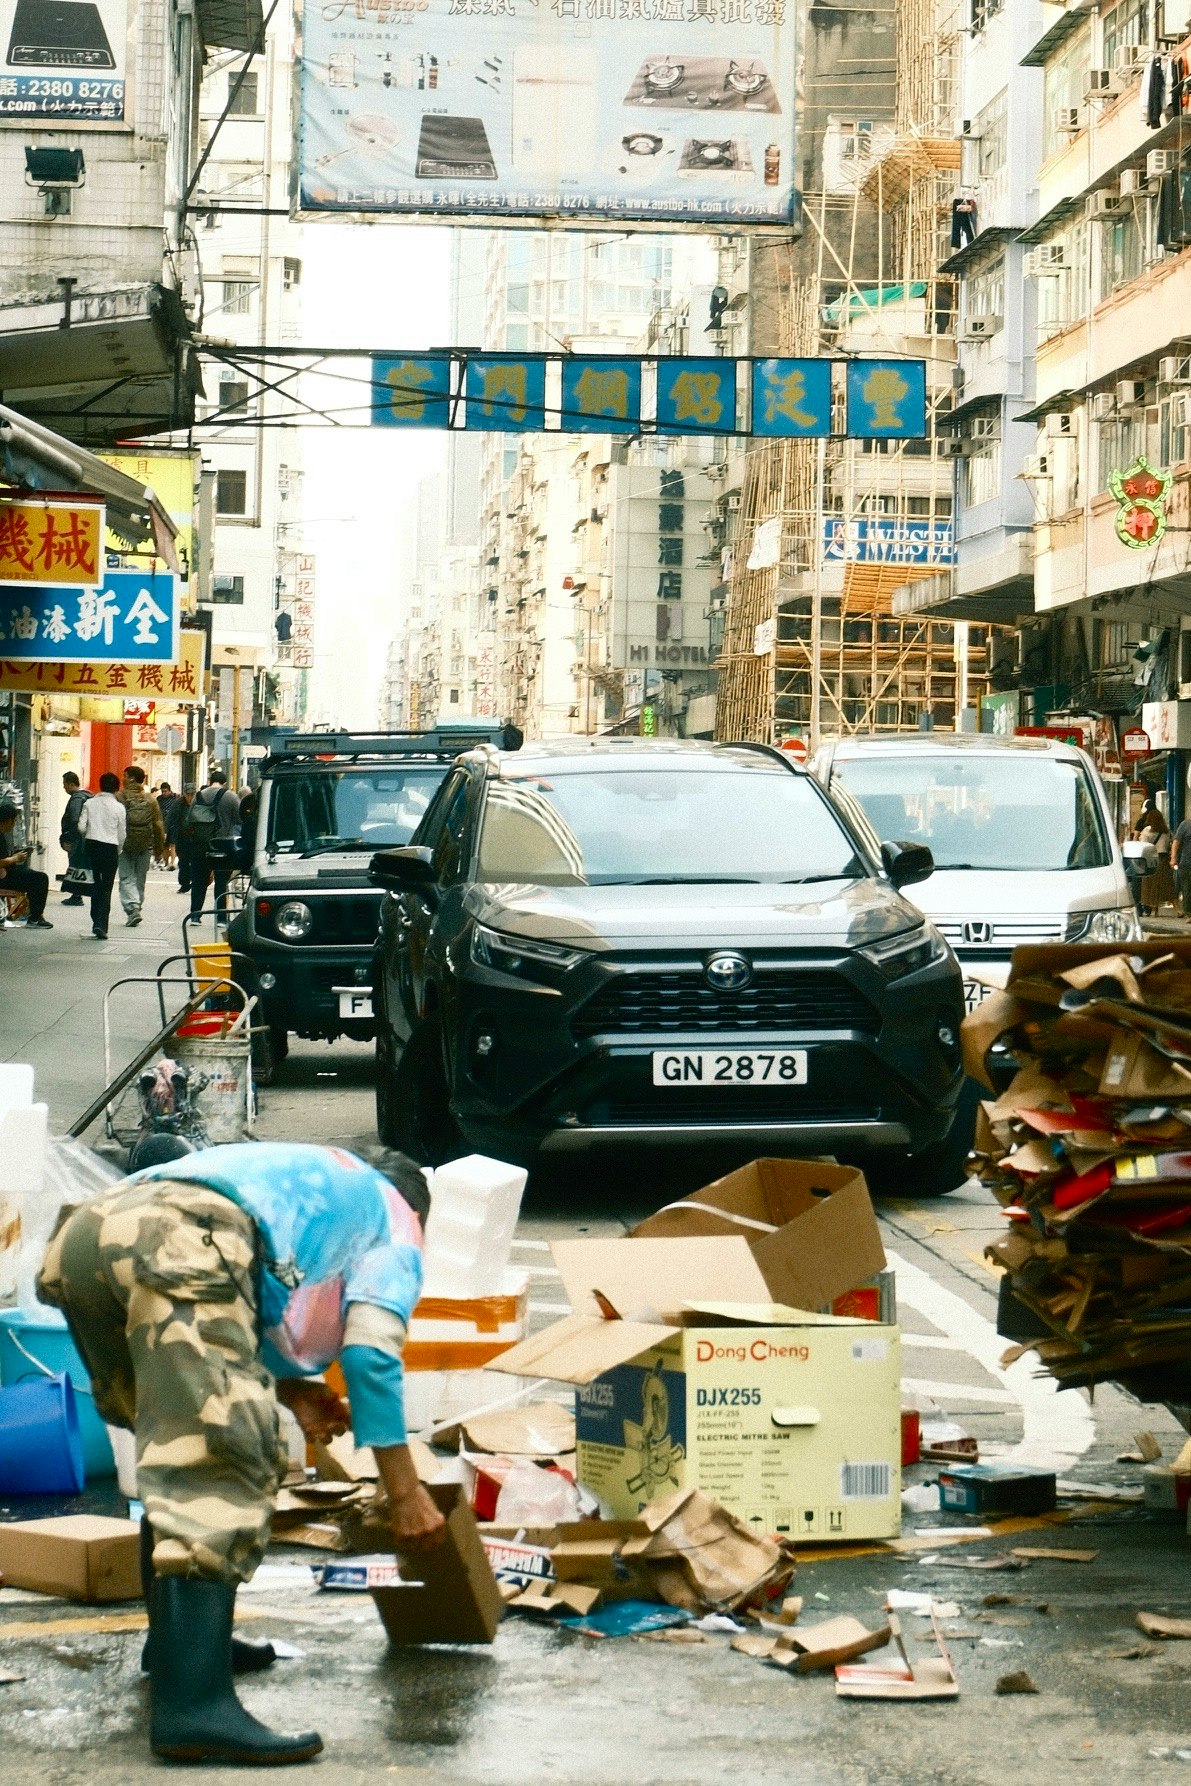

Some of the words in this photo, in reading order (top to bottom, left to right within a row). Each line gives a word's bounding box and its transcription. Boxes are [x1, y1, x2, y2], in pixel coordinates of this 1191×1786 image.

[78, 81, 124, 99] 8276
[563, 194, 590, 208] 8276
[1125, 480, 1158, 495] 永信
[1125, 507, 1156, 540] 押
[630, 645, 648, 662] H1
[655, 645, 708, 662] HOTEL
[662, 1055, 703, 1081] GN
[714, 1054, 797, 1081] 2878
[696, 1388, 761, 1406] DJX255
